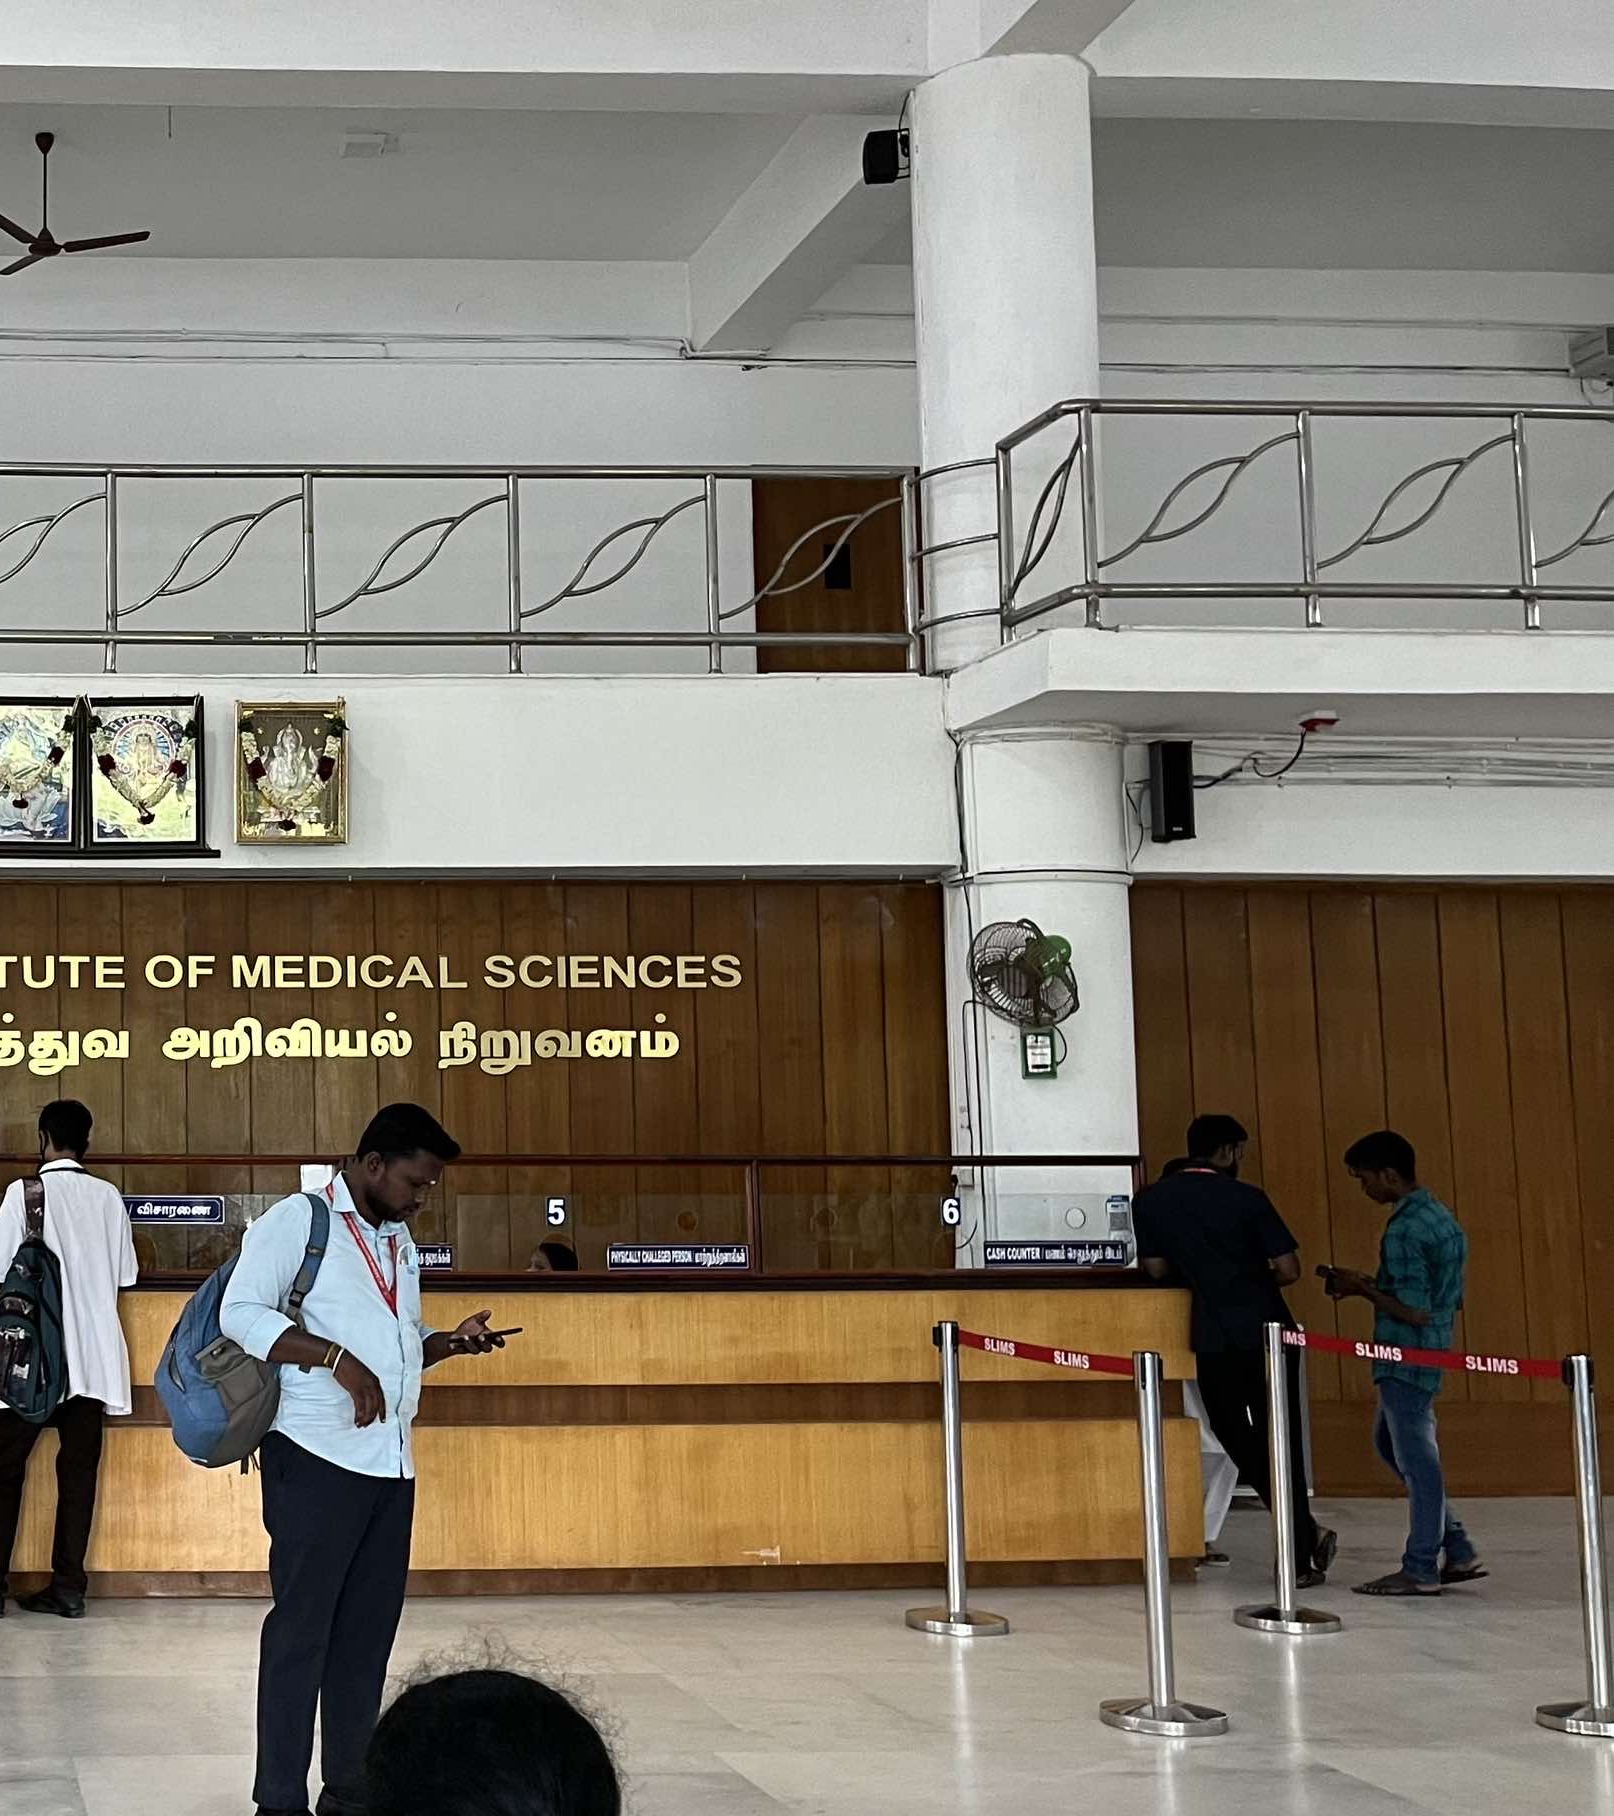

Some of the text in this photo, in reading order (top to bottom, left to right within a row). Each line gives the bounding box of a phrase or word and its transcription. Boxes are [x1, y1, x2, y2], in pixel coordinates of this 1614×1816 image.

[144, 954, 216, 989] OF
[231, 954, 468, 988] MEDICAL
[483, 954, 742, 988] SCIENCES
[161, 1011, 413, 1069] அறிவியல்
[438, 1013, 680, 1075] நிறுவனம்
[136, 1201, 212, 1218] விசாரணை
[547, 1199, 566, 1225] 5
[942, 1198, 960, 1225] 6
[986, 1247, 1006, 1260] CASH
[1007, 1247, 1041, 1260] COUNTER
[983, 1336, 1016, 1357] SLIMS
[1282, 1330, 1307, 1346] IMS
[1053, 1349, 1090, 1370] SLIMS
[1354, 1342, 1403, 1362] SLIMS
[1465, 1355, 1519, 1375] SLIMS
